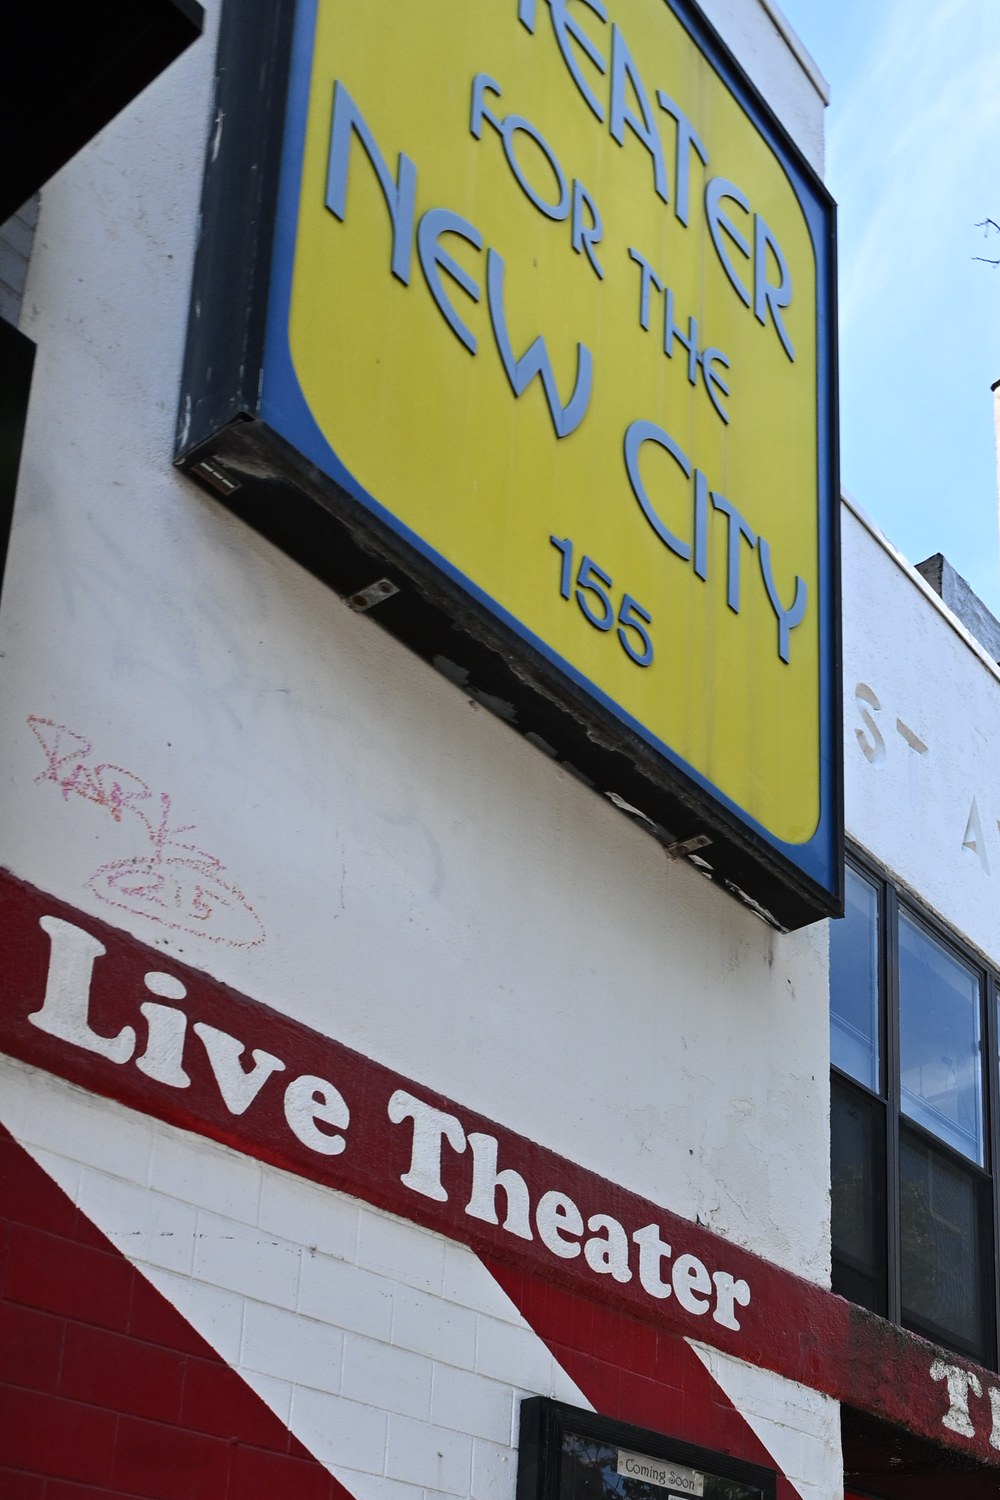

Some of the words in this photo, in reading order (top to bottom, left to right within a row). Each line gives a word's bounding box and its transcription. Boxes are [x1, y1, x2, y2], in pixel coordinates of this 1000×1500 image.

[470, 73, 604, 281] FOR
[627, 247, 731, 426] THE
[519, 0, 795, 363] EATER
[325, 79, 593, 440] NEW
[624, 419, 808, 665] CITY
[551, 535, 654, 667] 155
[27, 915, 351, 1156] Live
[387, 1089, 751, 1332] Theater
[625, 1458, 666, 1485] Coming
[668, 1470, 695, 1491] Soon
